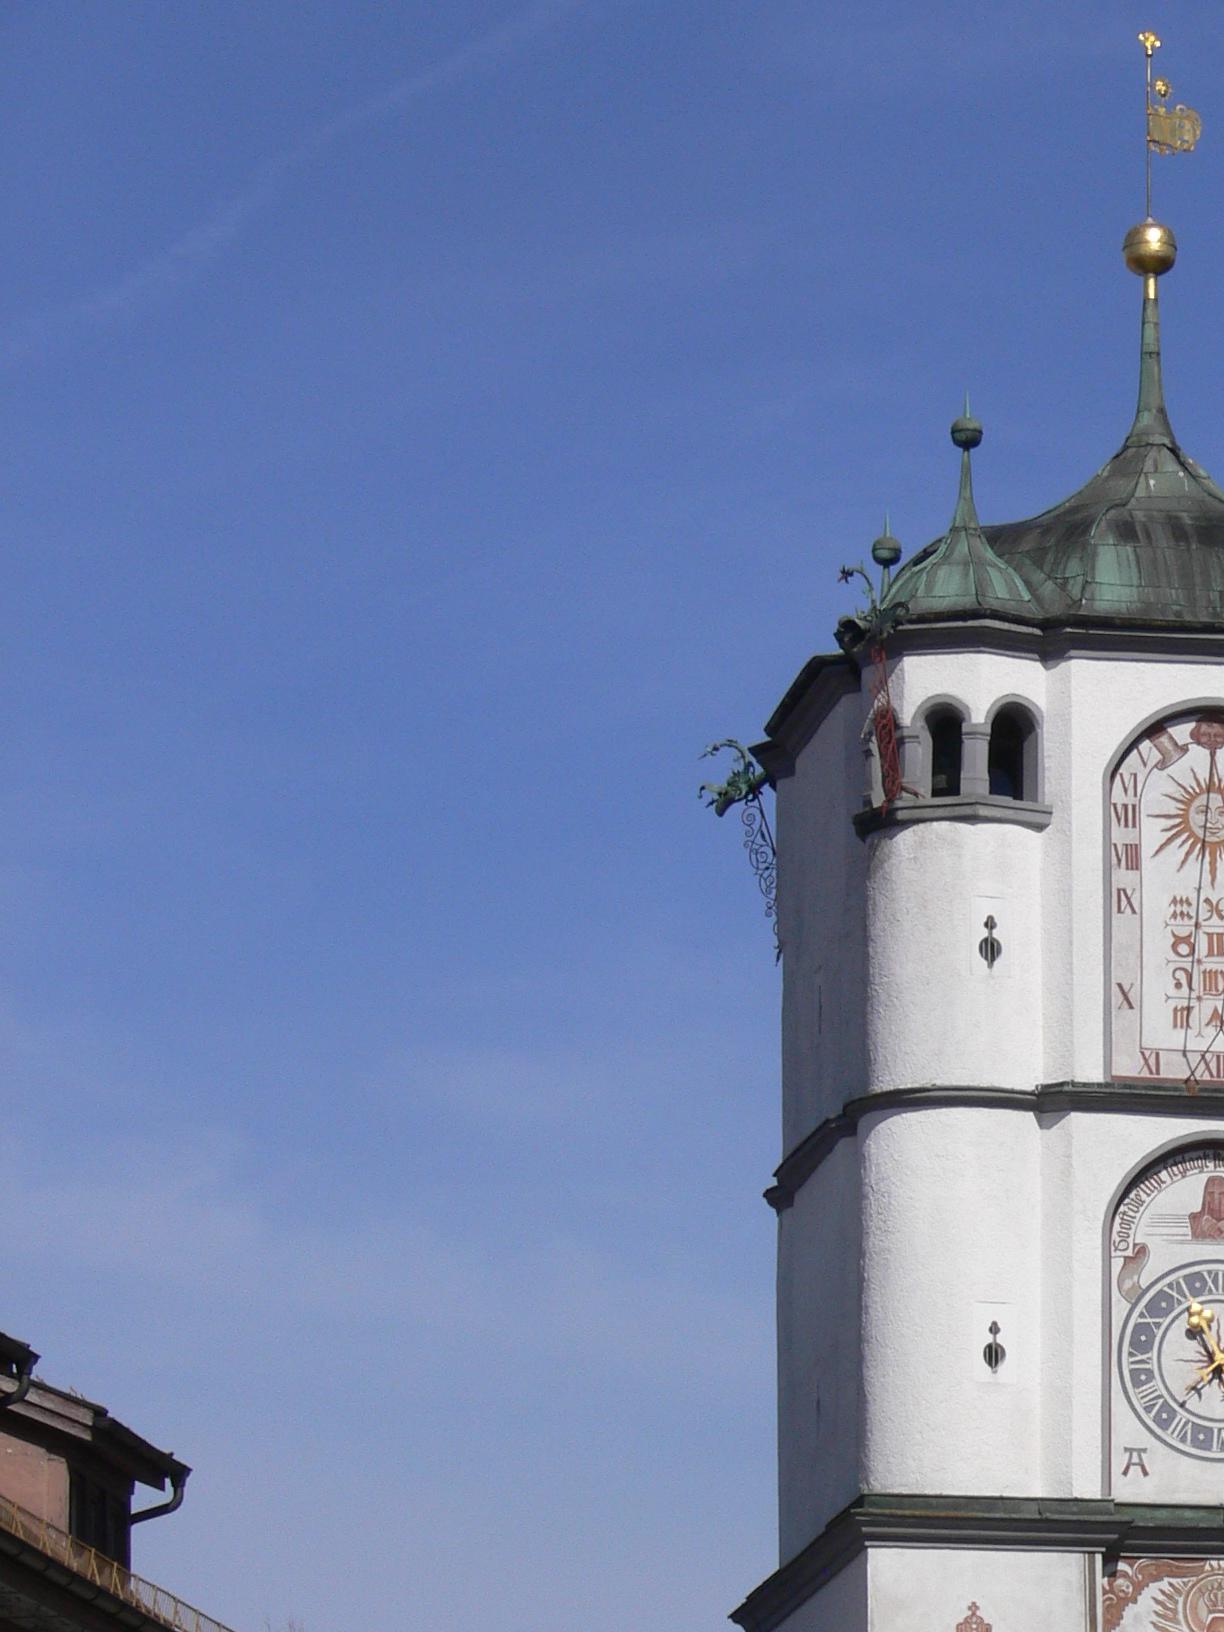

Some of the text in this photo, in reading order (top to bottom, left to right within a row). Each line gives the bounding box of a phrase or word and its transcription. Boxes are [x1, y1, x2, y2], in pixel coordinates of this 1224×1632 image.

[1118, 773, 1138, 798] VI
[1112, 803, 1138, 829] VII
[1113, 842, 1139, 871] VIII
[1116, 888, 1137, 915] IX
[1116, 983, 1135, 1010] X
[1139, 1051, 1161, 1076] XI
[1162, 1278, 1191, 1307] XI
[1137, 1308, 1166, 1332] X
[1129, 1348, 1152, 1369] IX
[1136, 1383, 1164, 1420] VIII
[1168, 1414, 1192, 1447] VII
